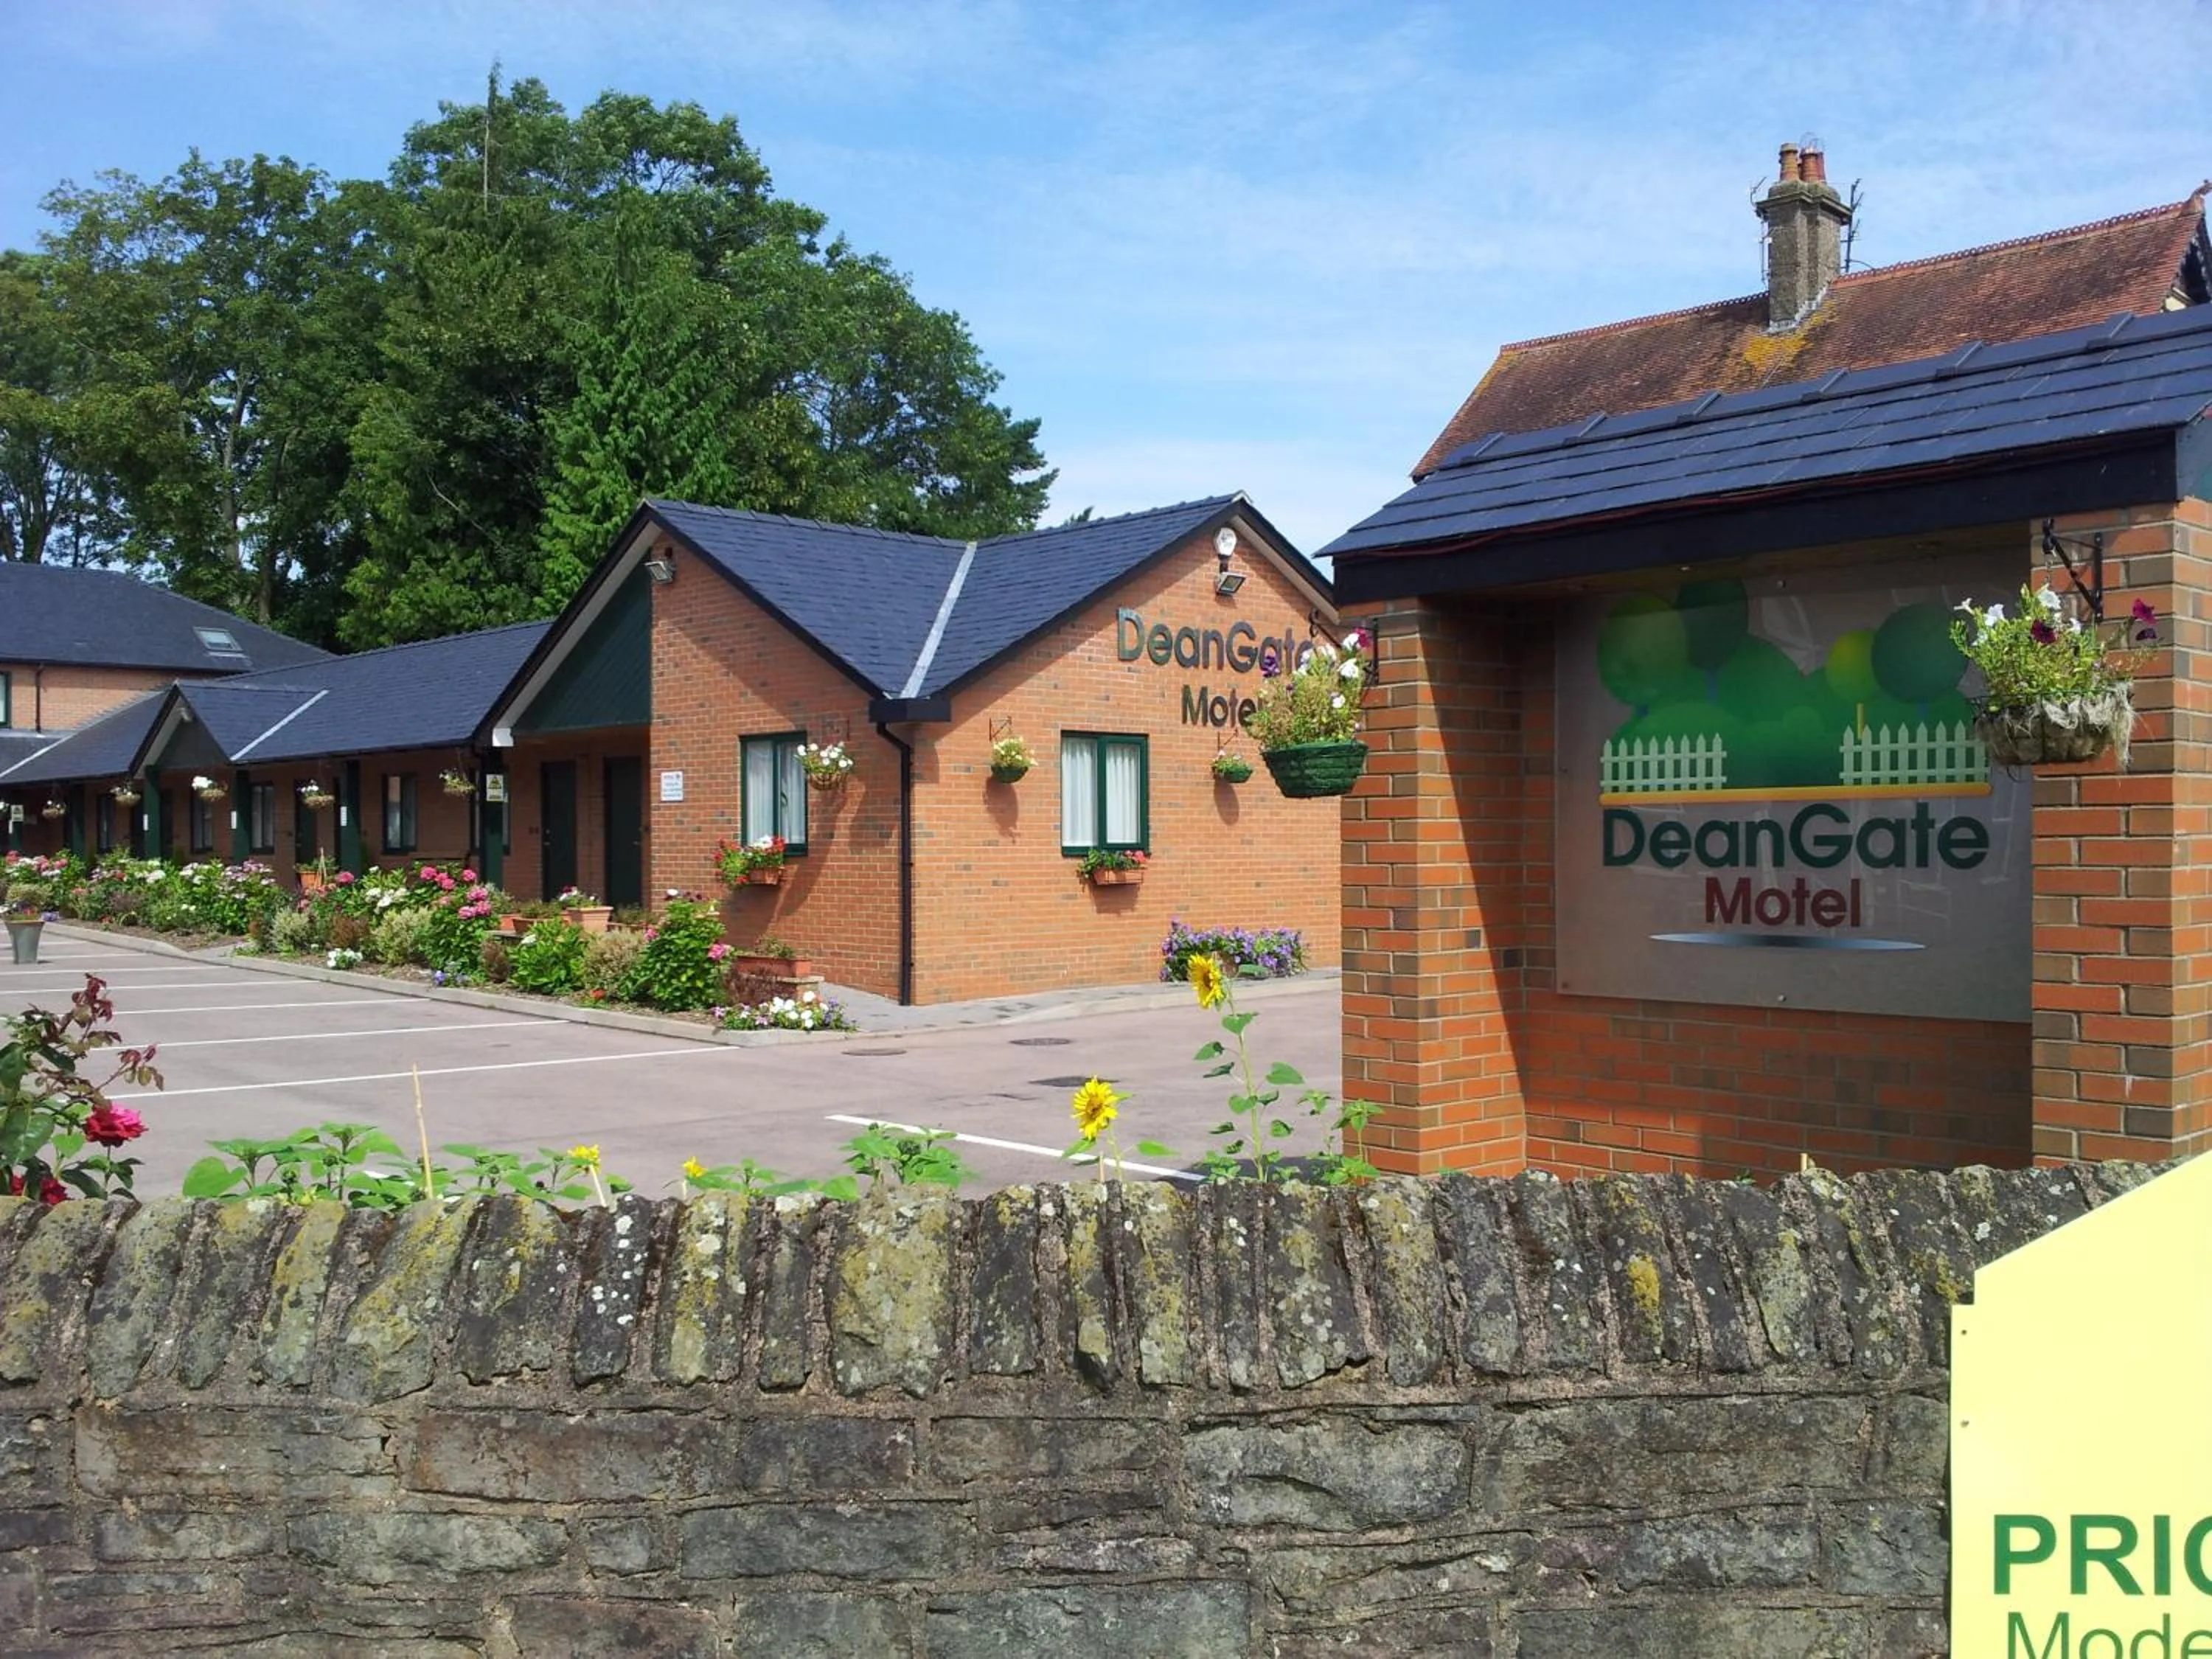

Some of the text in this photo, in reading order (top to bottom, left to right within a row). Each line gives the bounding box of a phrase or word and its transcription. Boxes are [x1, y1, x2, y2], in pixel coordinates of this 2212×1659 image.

[1181, 684, 1264, 728] Mote
[1602, 802, 1990, 870] DeanGate
[1705, 877, 1861, 928] Motel
